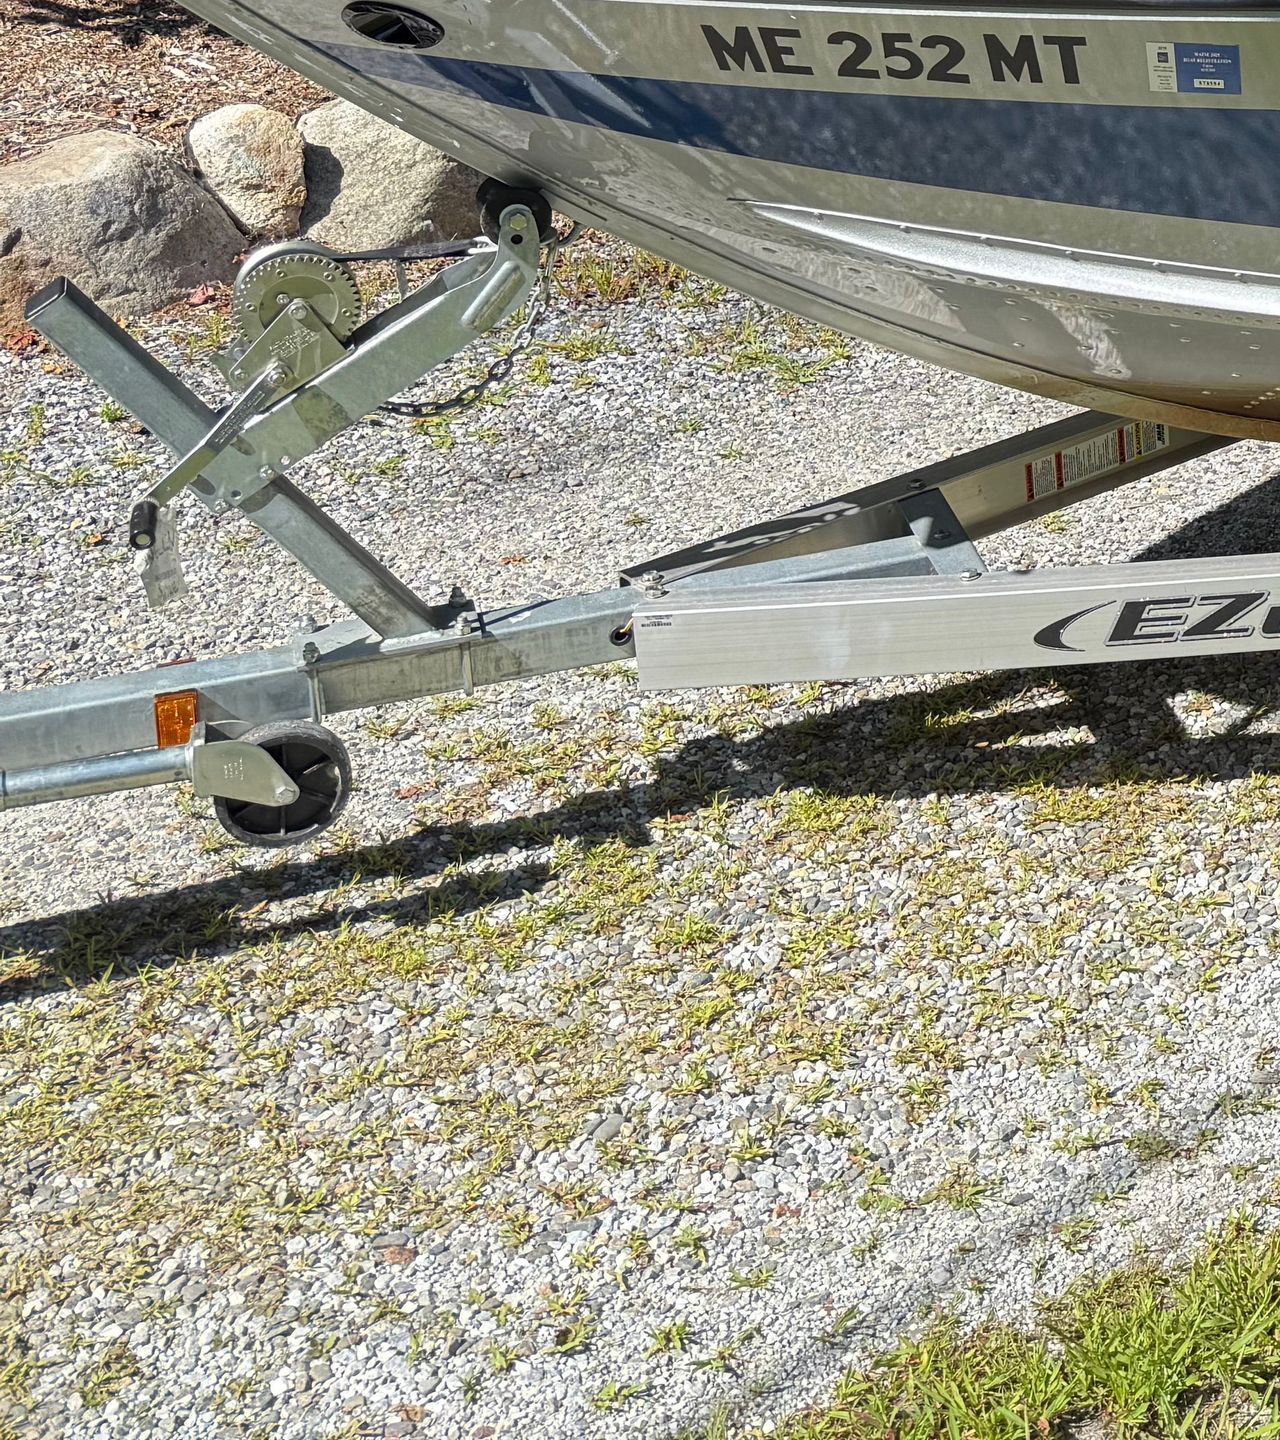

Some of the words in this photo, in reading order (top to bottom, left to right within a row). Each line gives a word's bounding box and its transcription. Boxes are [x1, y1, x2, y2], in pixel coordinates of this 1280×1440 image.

[700, 24, 814, 76] ME
[827, 30, 971, 85] 252
[983, 33, 1088, 85] MT
